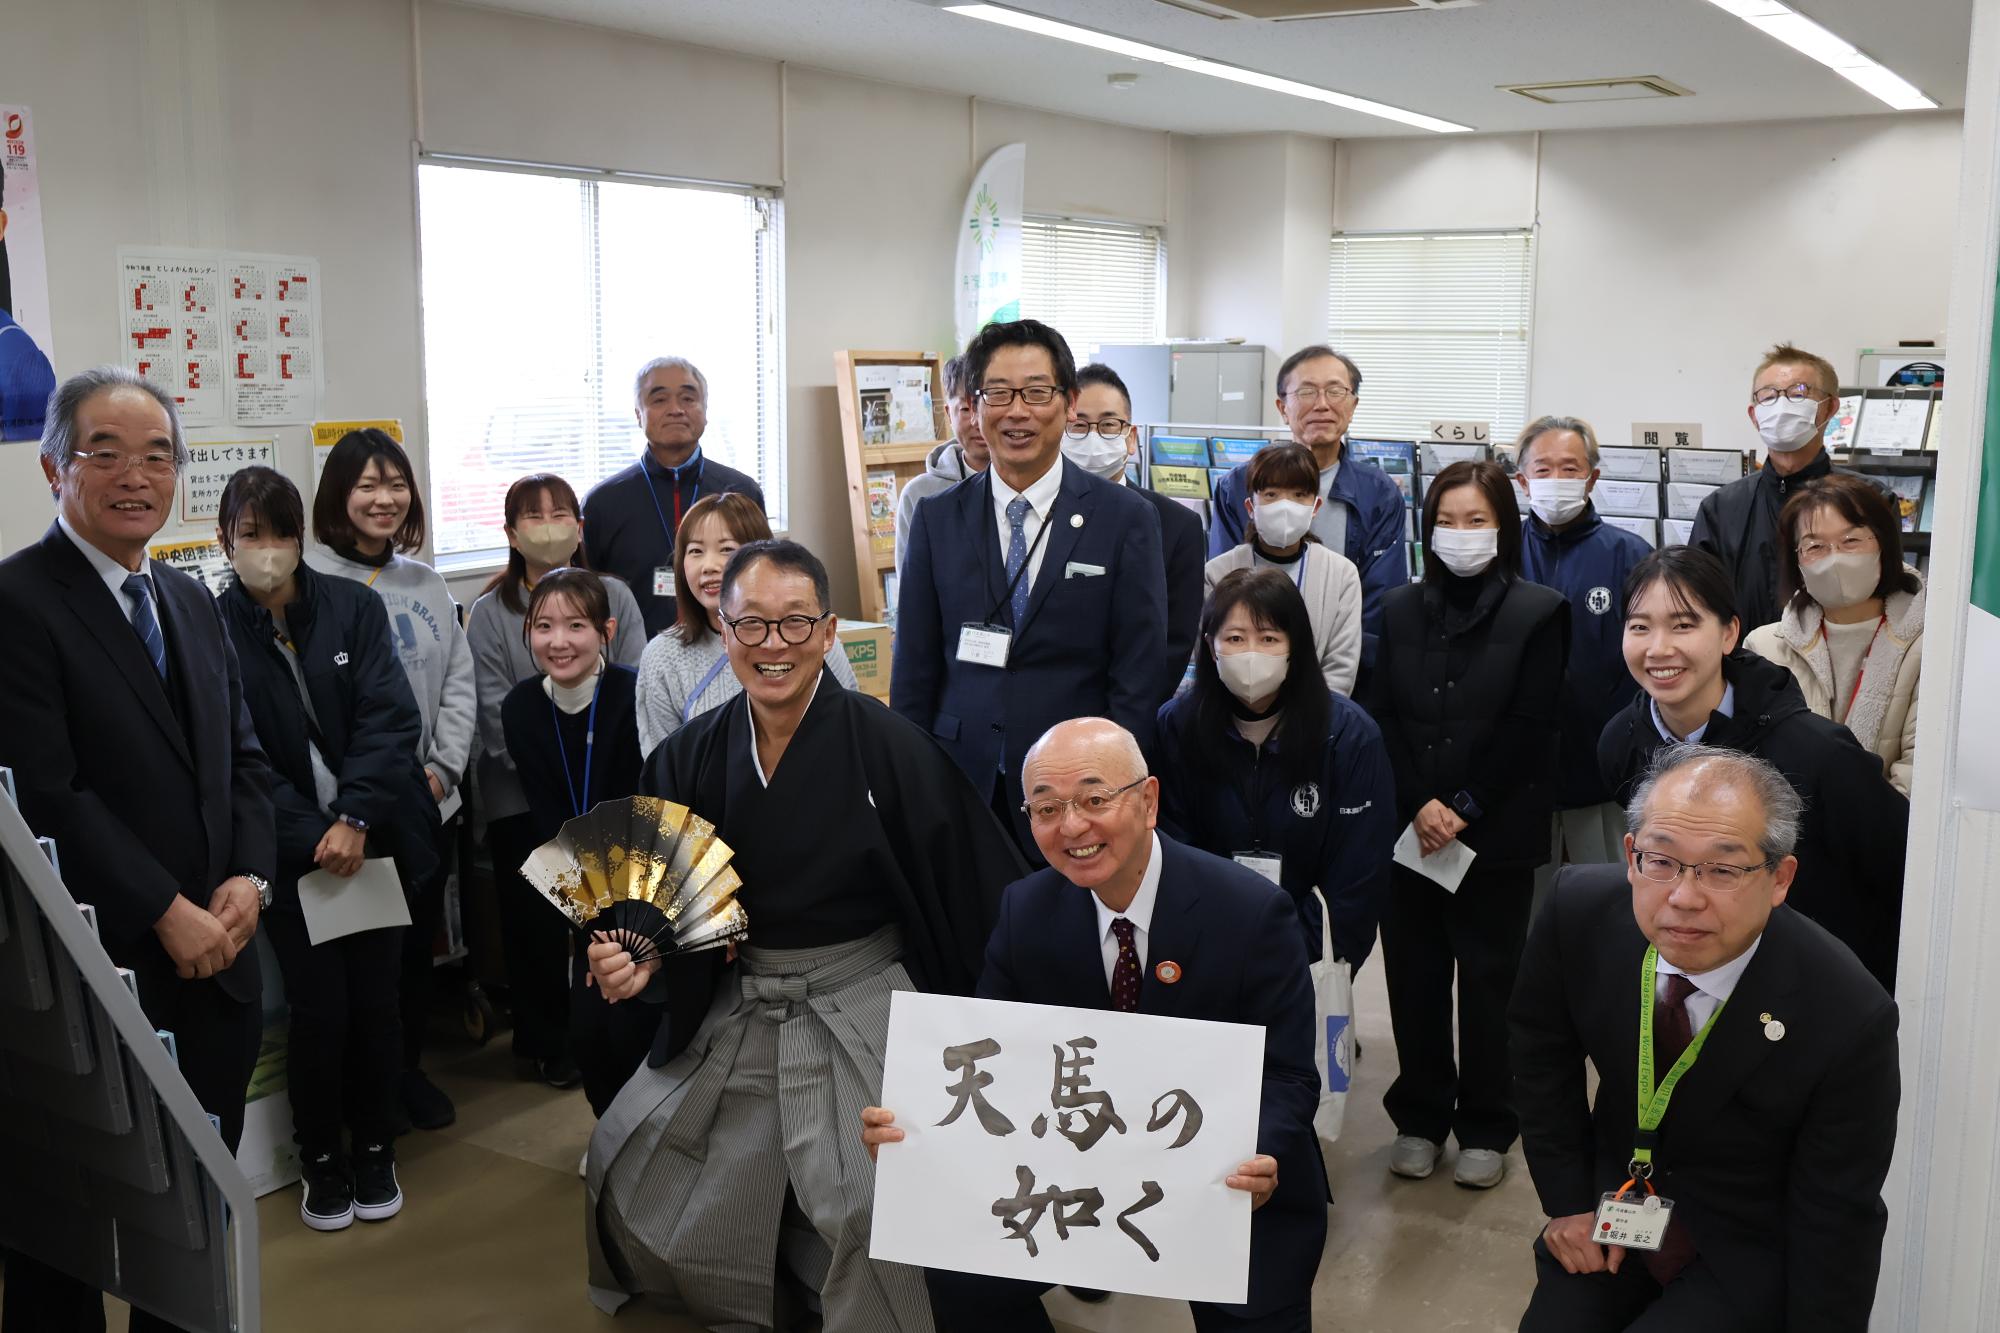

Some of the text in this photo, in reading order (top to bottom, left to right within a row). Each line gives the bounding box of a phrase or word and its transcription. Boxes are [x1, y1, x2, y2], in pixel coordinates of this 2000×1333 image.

[7, 144, 25, 155] 119
[1434, 424, 1486, 441] くらし
[1644, 431, 1690, 446] 閲覧
[1641, 1035, 1651, 1065] World
[932, 1036, 1204, 1152] 天馬の
[1639, 1067, 1651, 1095] Expo
[991, 1164, 1166, 1263] 如く
